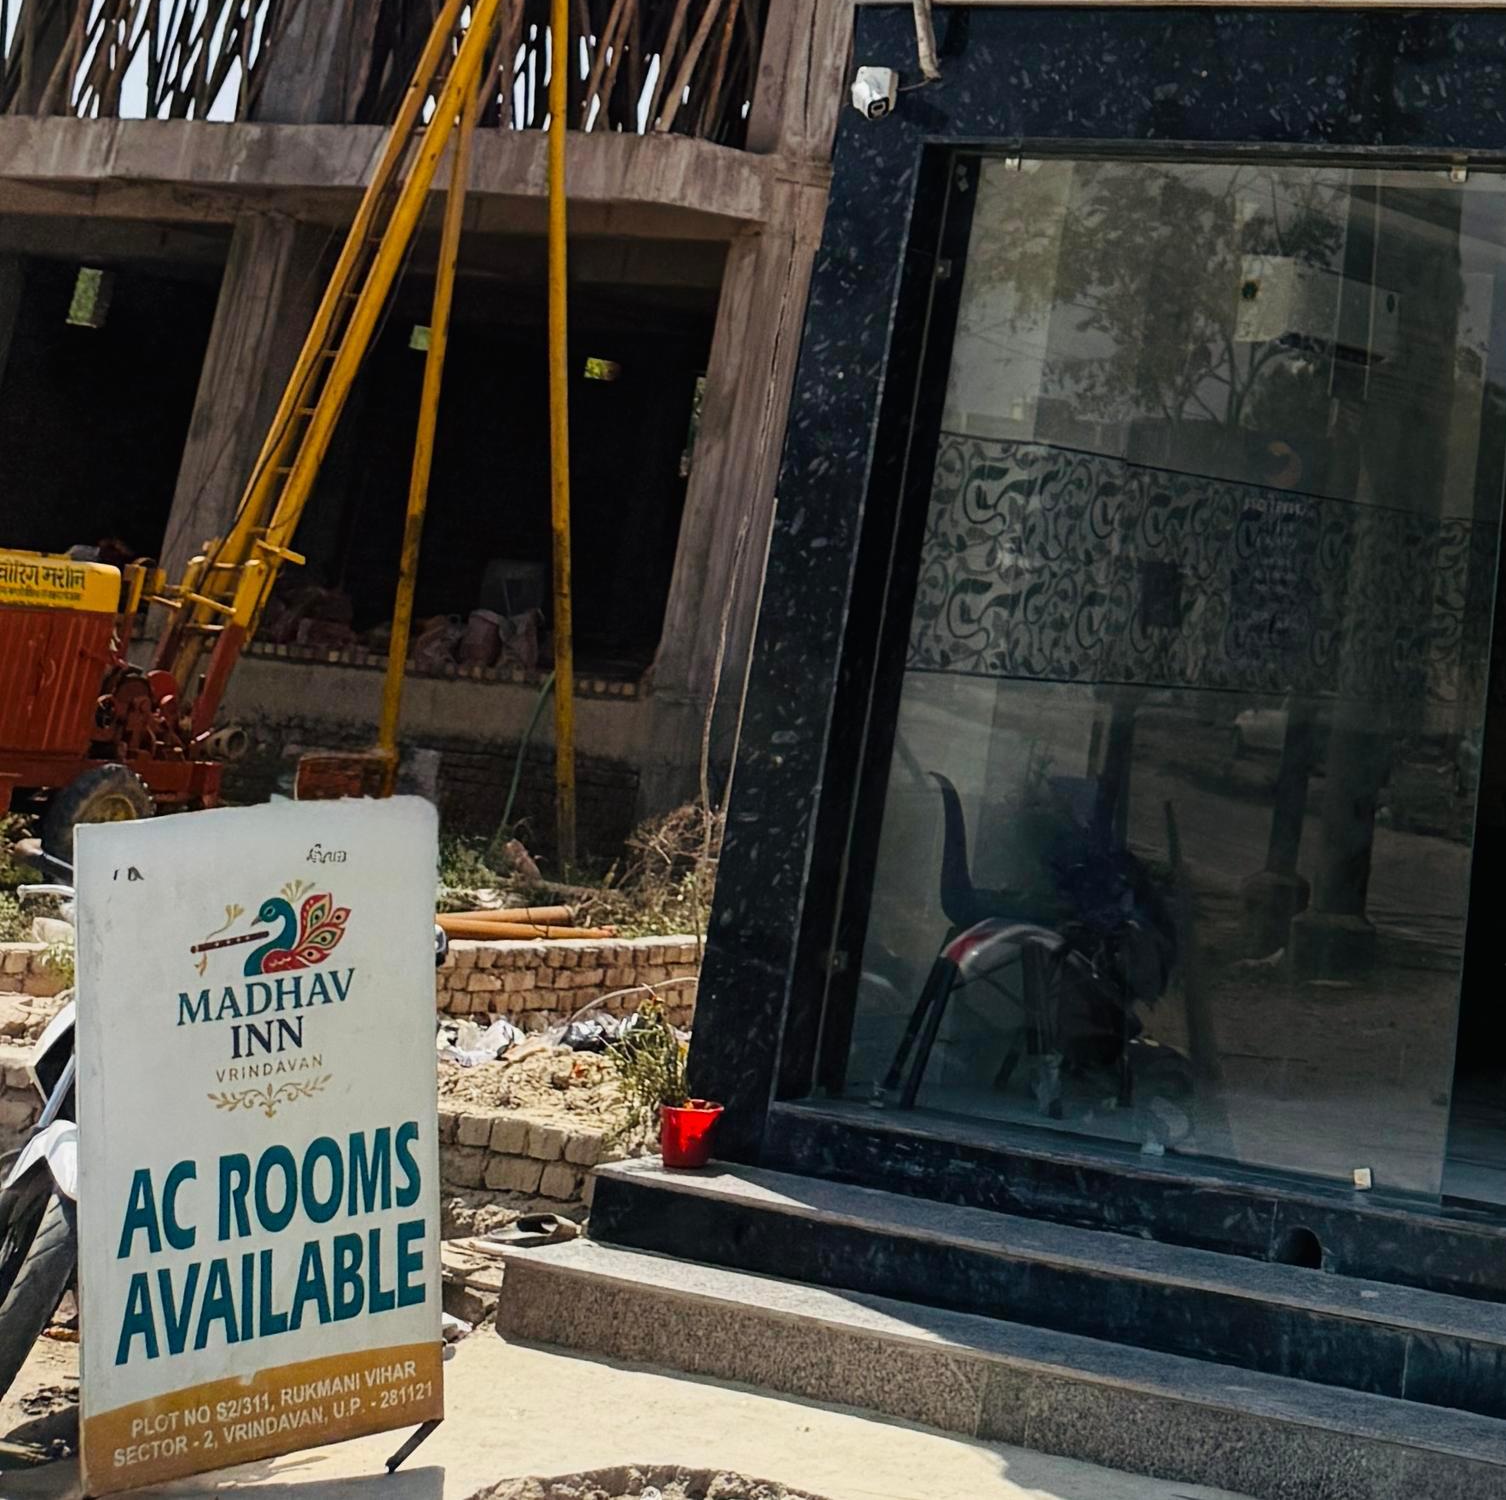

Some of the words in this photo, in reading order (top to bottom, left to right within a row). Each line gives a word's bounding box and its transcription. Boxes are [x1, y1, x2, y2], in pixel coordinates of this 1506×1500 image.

[177, 968, 355, 1026] MADHAV
[216, 1054, 323, 1083] VRINDAVAN
[230, 1015, 303, 1059] INN
[117, 1159, 196, 1260] AC
[218, 1120, 421, 1241] ROOMS
[115, 1218, 426, 1366] AVAILABLE
[113, 1436, 188, 1468] SECTOR
[223, 1410, 328, 1443] VRINDAVAN,
[333, 1399, 365, 1420] U.P.
[380, 1380, 433, 1410] 281121
[132, 1412, 179, 1439] PLOT
[184, 1405, 211, 1427] NO
[281, 1373, 360, 1406] RUKMANI
[365, 1361, 416, 1387] VIHAR
